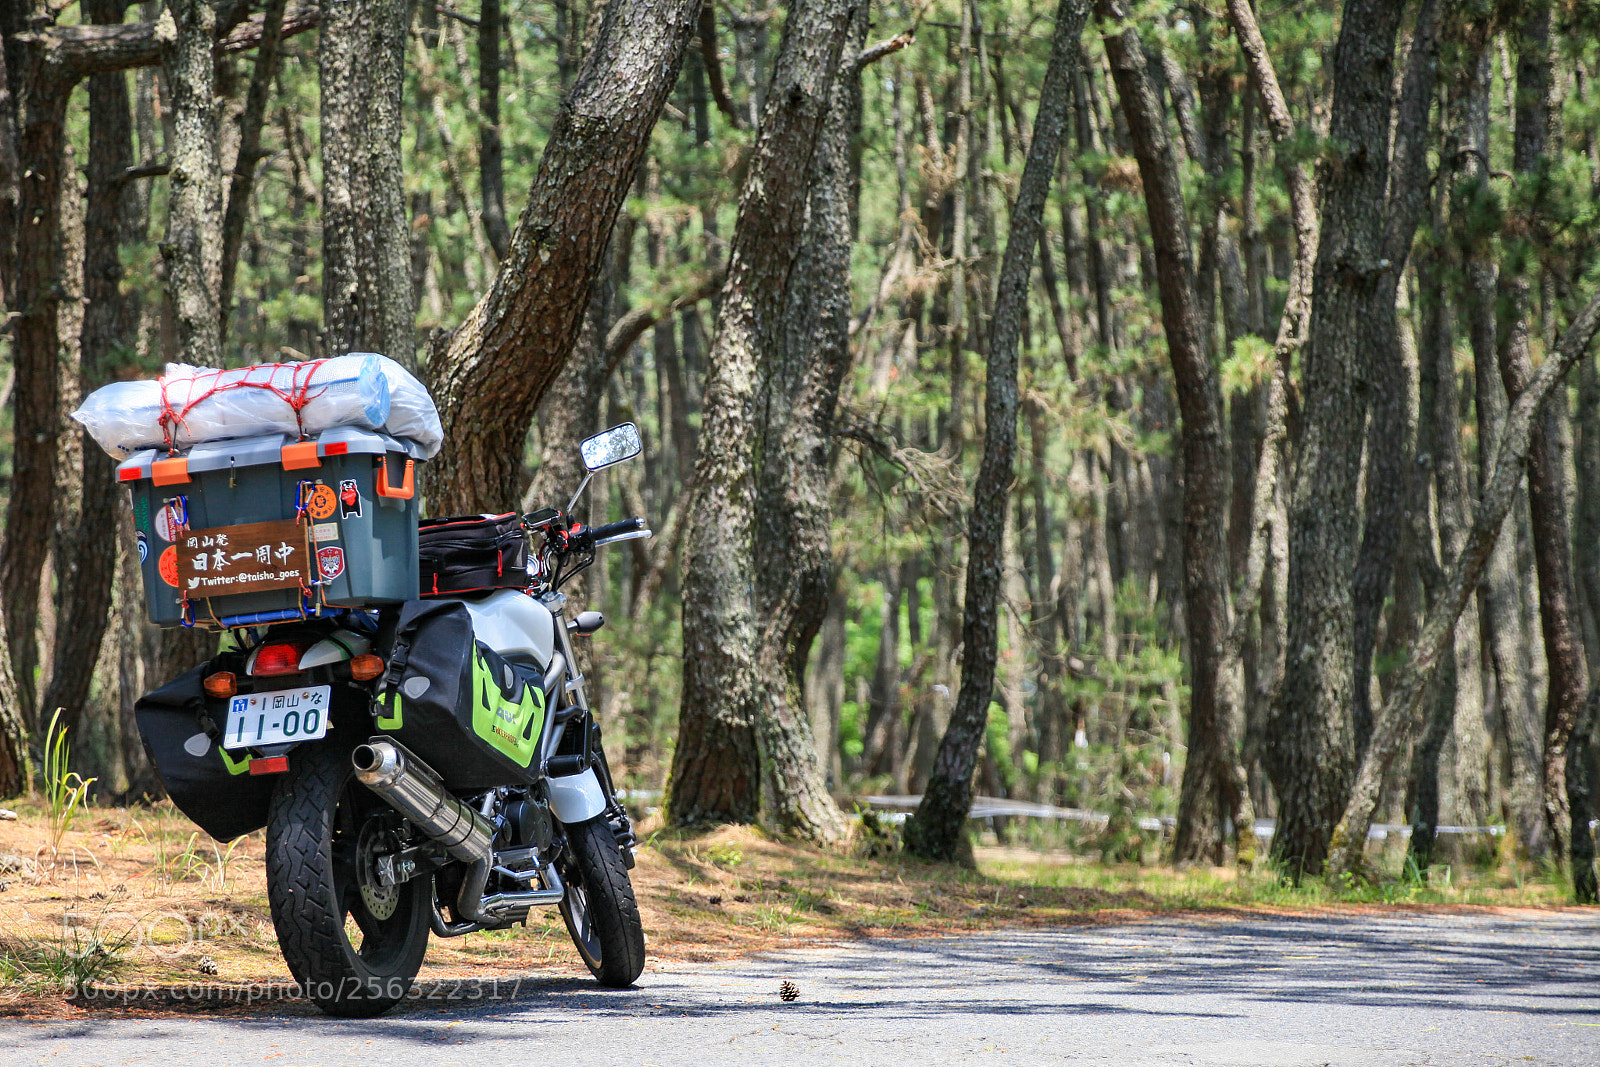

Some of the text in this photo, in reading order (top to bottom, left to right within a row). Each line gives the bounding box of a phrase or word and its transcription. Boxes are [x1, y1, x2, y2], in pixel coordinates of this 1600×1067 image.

[187, 533, 229, 549] 岡山発
[191, 541, 296, 572] 日本一周中
[201, 569, 300, 587] Twitter:@taisho_goes
[272, 694, 300, 710] 岡山
[310, 691, 323, 705] な
[236, 708, 321, 743] 11-00
